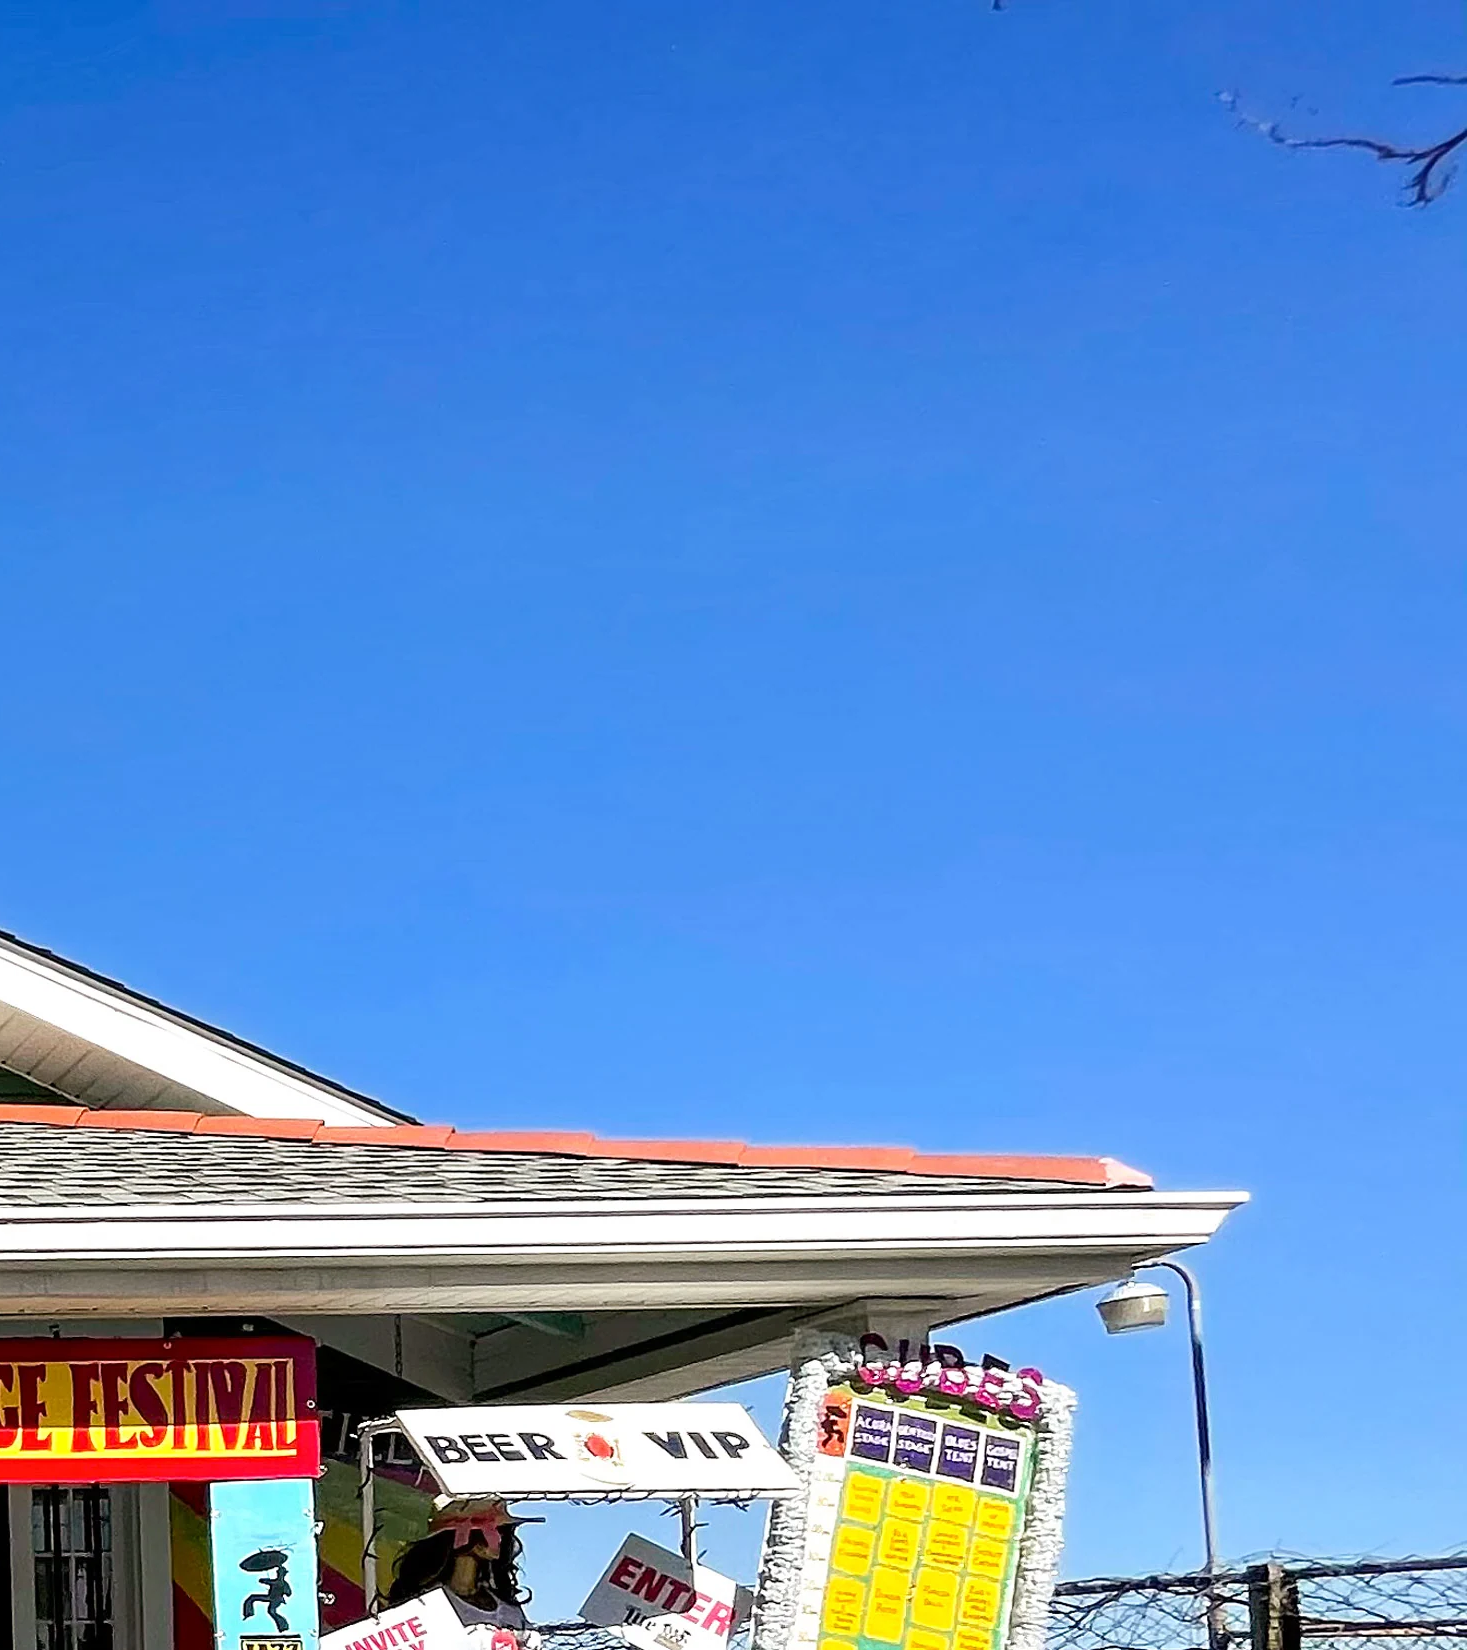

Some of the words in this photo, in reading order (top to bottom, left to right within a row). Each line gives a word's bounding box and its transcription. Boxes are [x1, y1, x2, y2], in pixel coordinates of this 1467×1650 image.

[69, 1360, 297, 1453] FESTIVAL
[424, 1431, 567, 1464] BEER
[642, 1430, 752, 1460] VIP
[608, 1554, 737, 1638] ENTER
